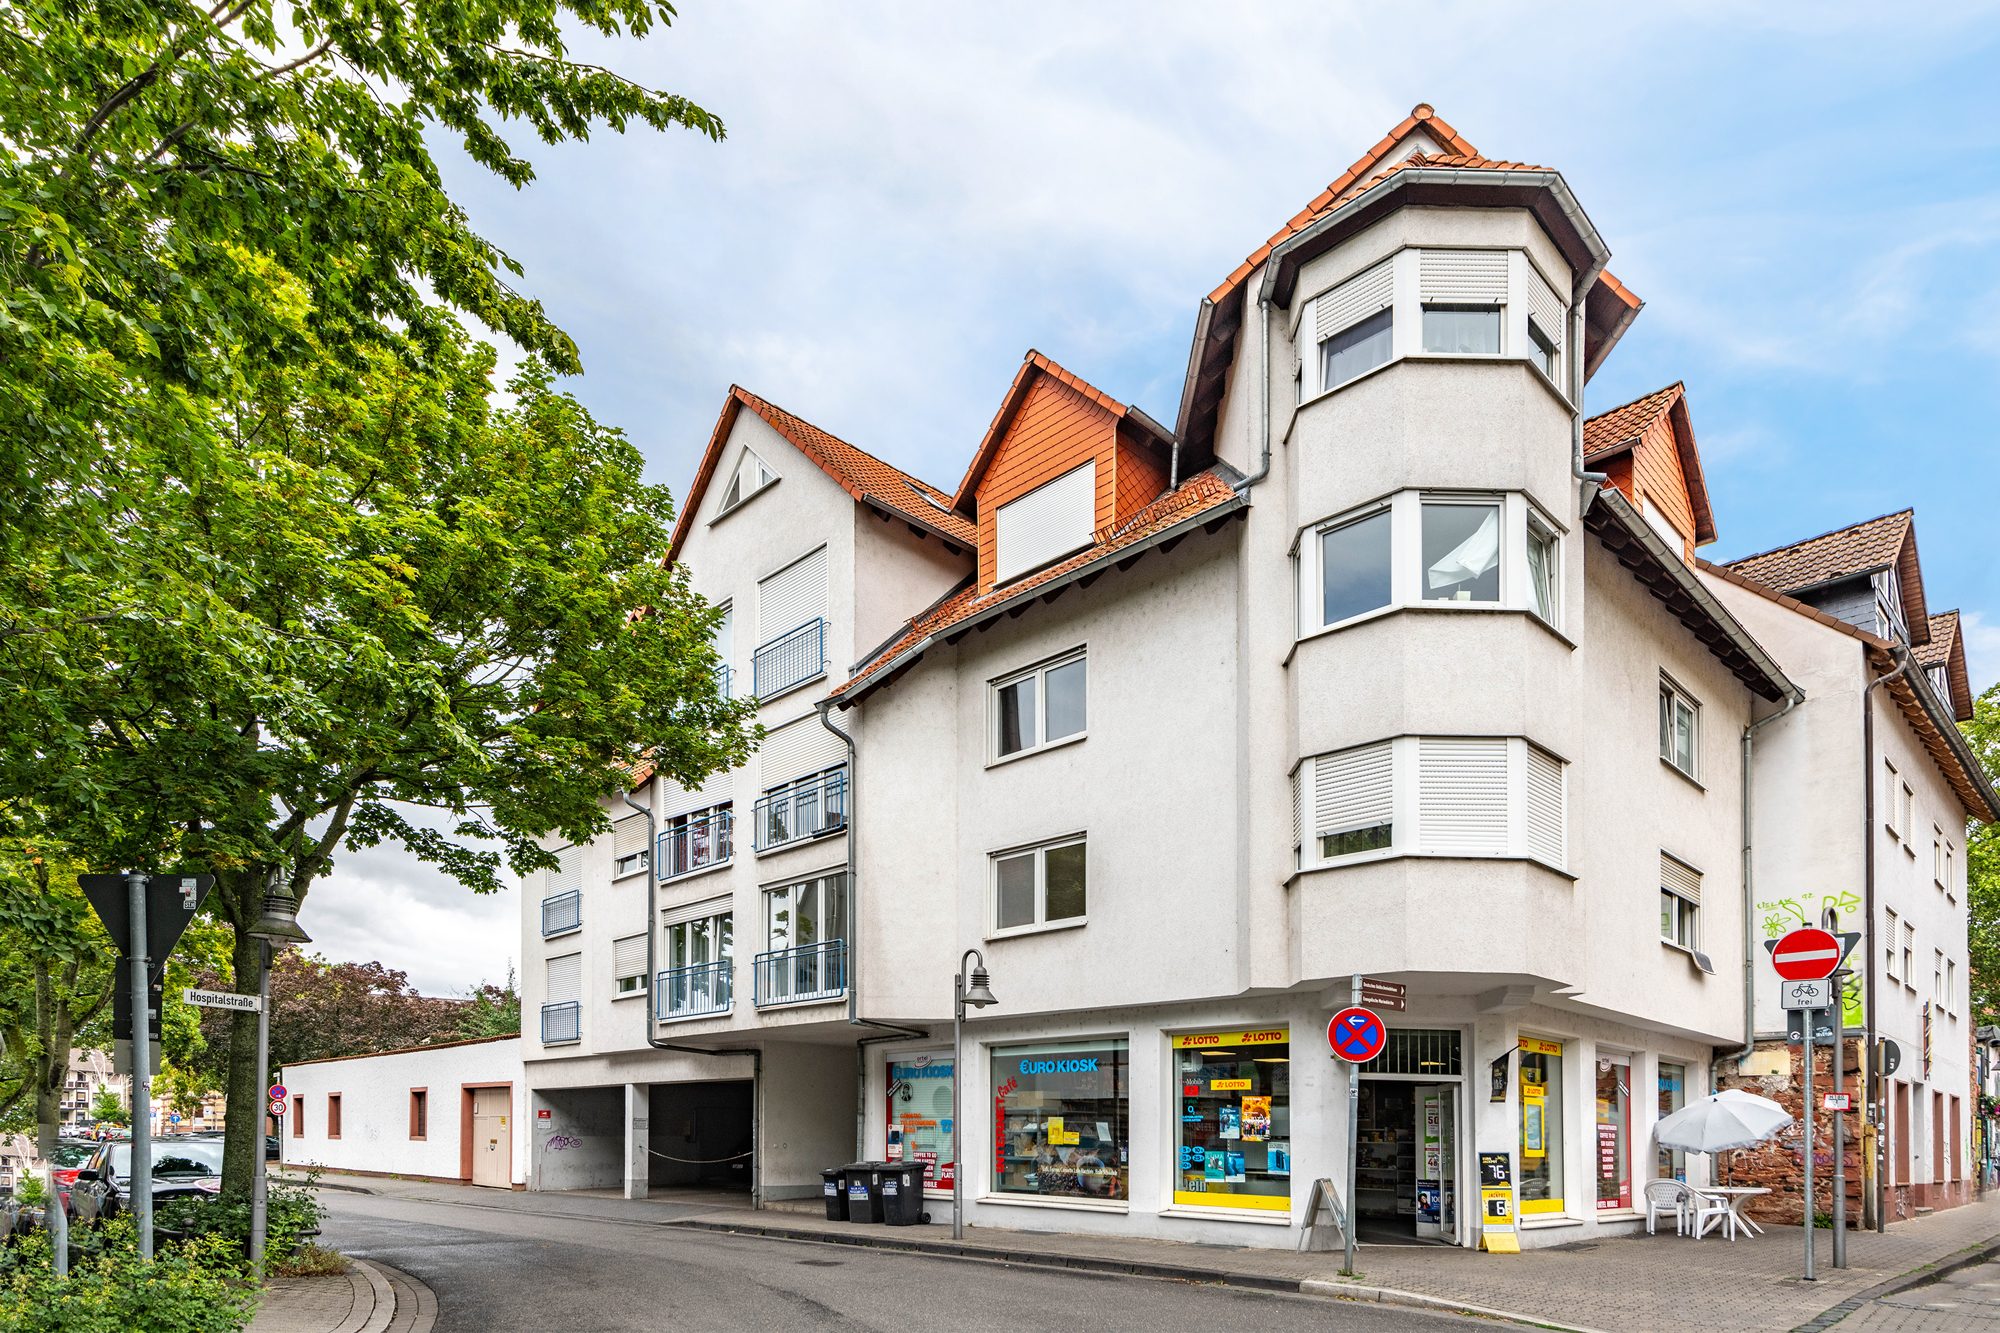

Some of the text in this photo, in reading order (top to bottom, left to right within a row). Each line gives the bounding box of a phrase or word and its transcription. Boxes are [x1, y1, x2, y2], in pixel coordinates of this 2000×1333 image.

[190, 991, 254, 1008] Hospitalstraße
[1797, 998, 1813, 1006] frei
[1193, 1036, 1219, 1045] LOTTO
[1253, 1032, 1282, 1042] LOTTO
[1056, 1057, 1099, 1073] KIOSK
[997, 1075, 1018, 1098] Café
[273, 1103, 284, 1112] 30
[995, 1095, 1006, 1173] INTERNET
[1489, 1165, 1505, 1179] 76
[1496, 1201, 1505, 1216] 6
